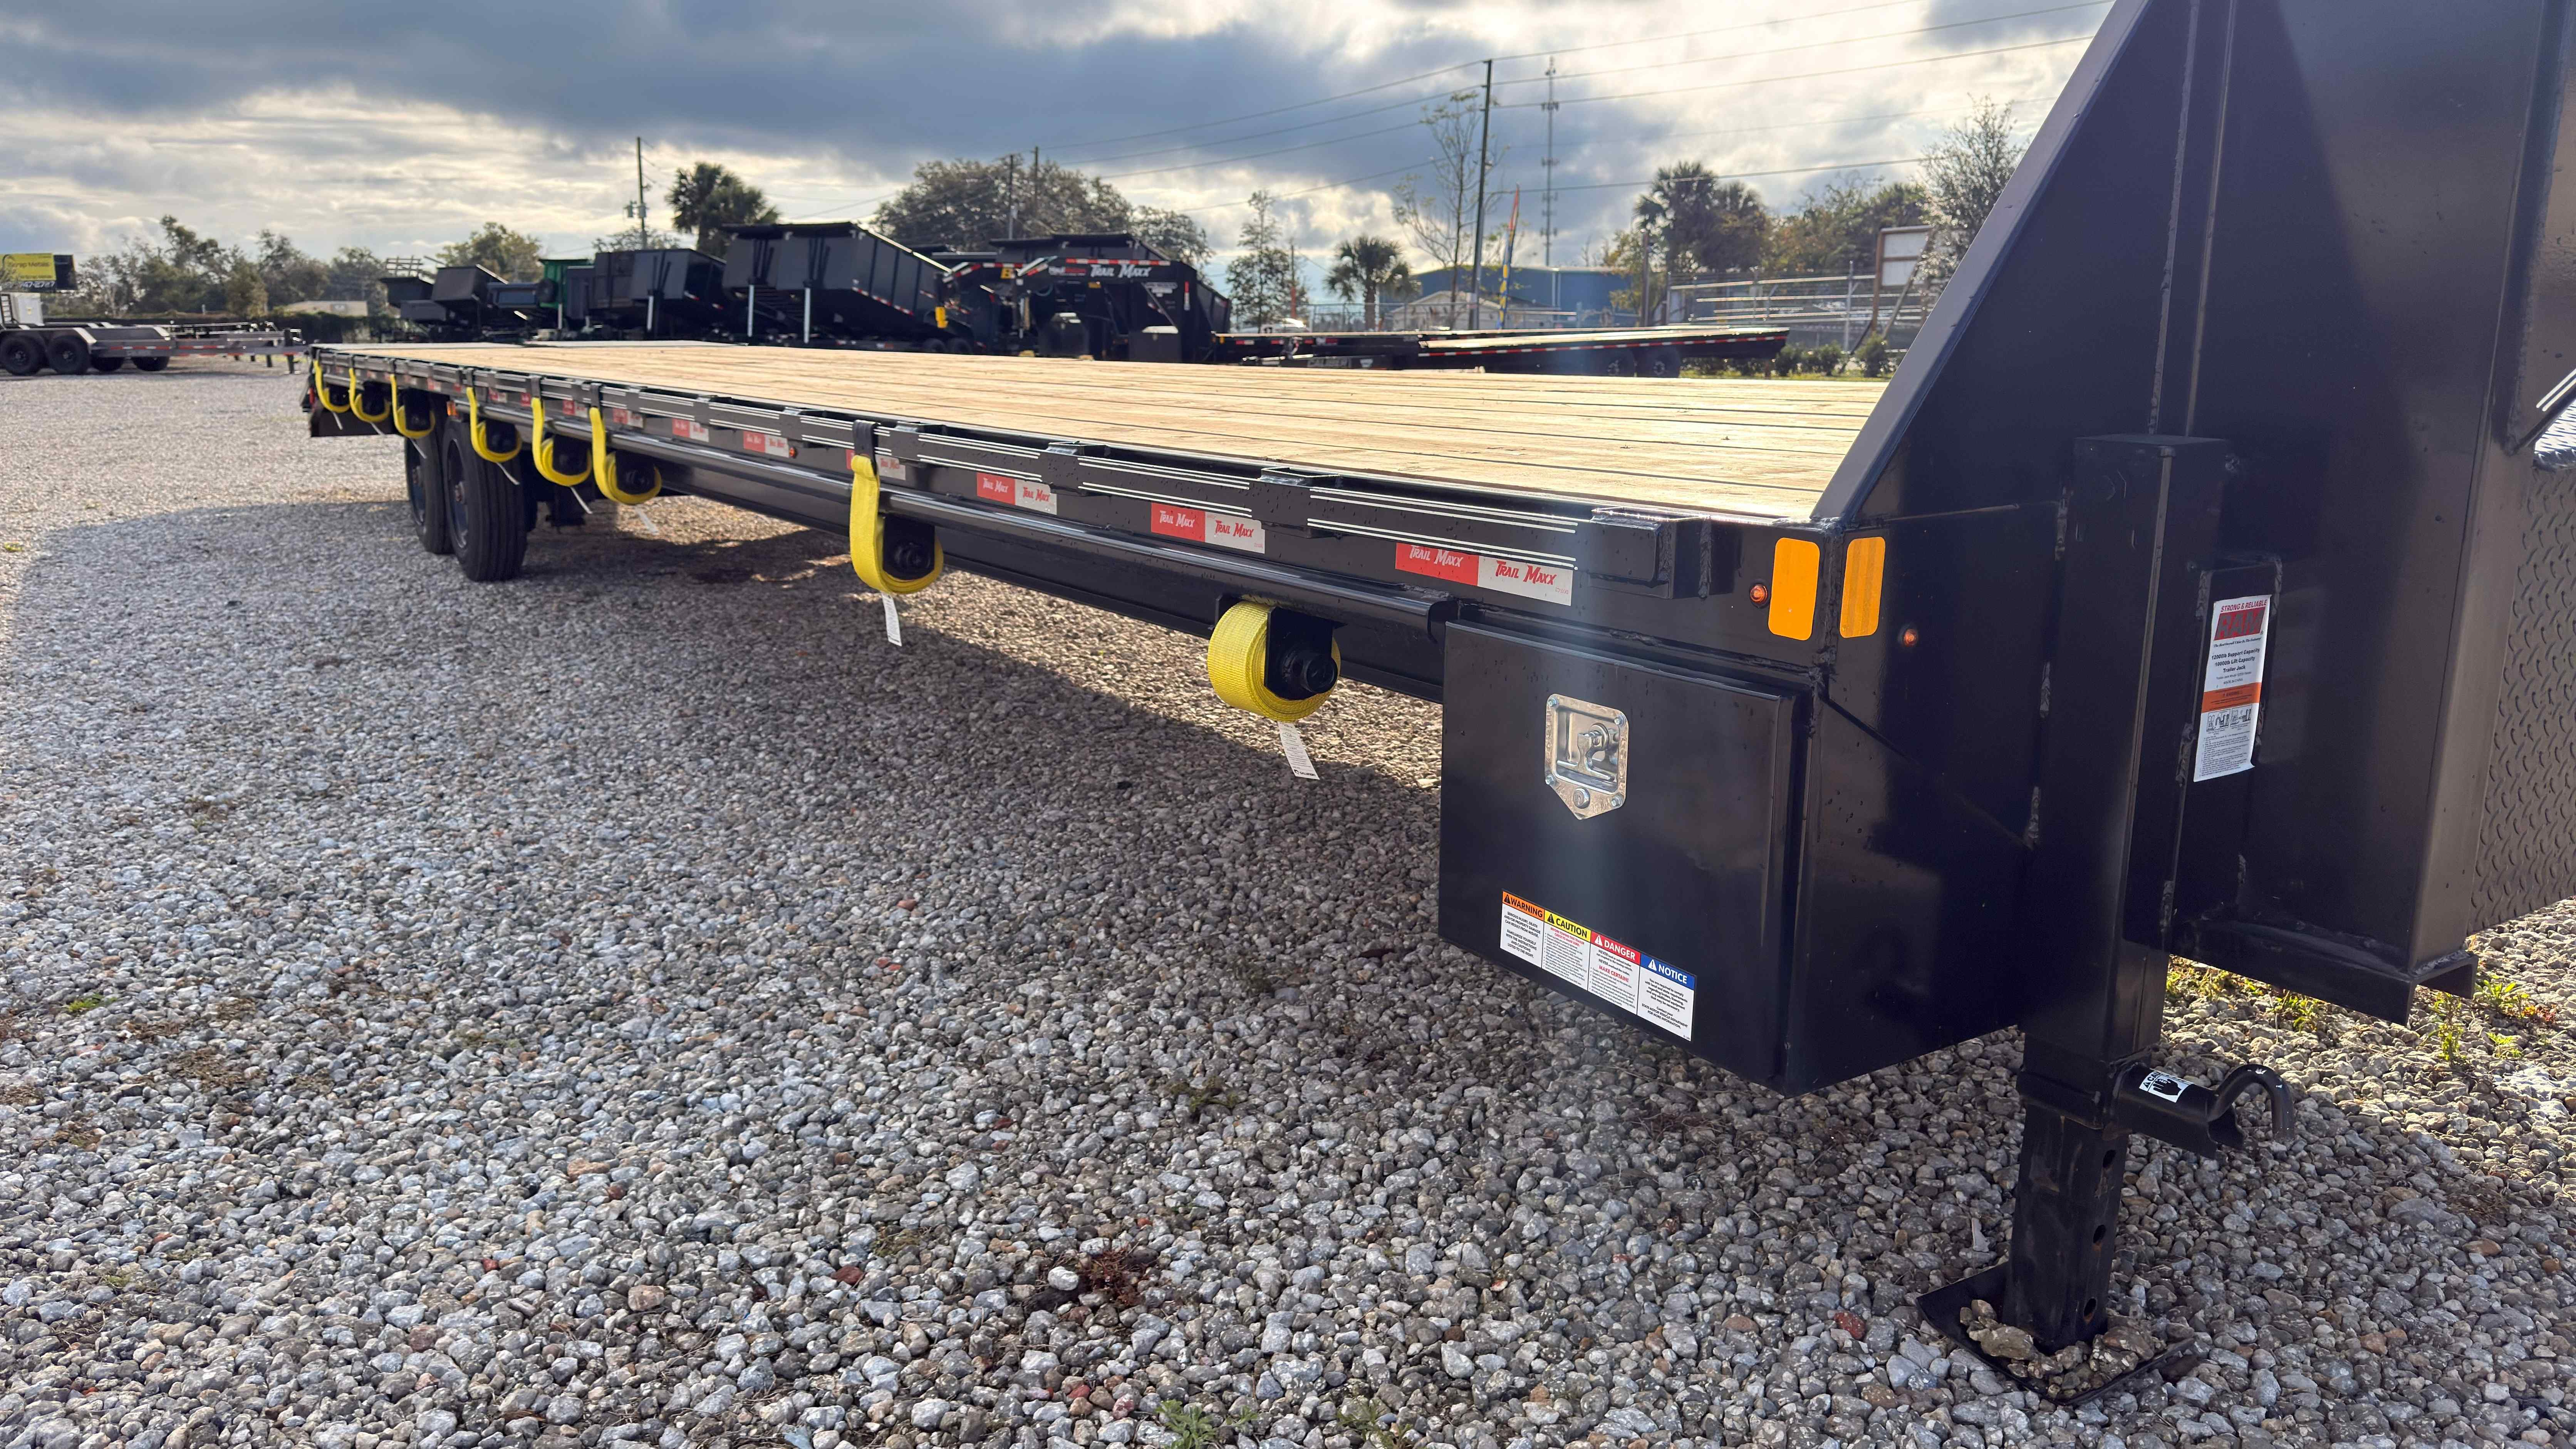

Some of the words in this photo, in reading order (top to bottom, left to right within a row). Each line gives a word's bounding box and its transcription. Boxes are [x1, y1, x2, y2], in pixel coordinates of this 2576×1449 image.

[1160, 510, 1173, 524] TRAIL
[1176, 513, 1195, 528] MAXX
[1216, 520, 1230, 534] TRAIL
[1233, 523, 1254, 537] MAXX
[1409, 545, 1430, 561] TRAIL
[1434, 549, 1463, 567] MAXX
[1495, 560, 1519, 578] TRAIL
[1523, 565, 1557, 585] MAXX
[2221, 603, 2241, 612] STRONG
[2245, 599, 2268, 609] RELIABLE
[2217, 610, 2264, 638] RAM
[1511, 897, 1543, 918] WARNING
[1556, 917, 1587, 938] CAUTION
[1604, 939, 1635, 960] DANGER
[1599, 964, 1610, 973] MAKE
[1611, 970, 1628, 982] CERTAIN!
[1659, 964, 1687, 984] NOTICE
